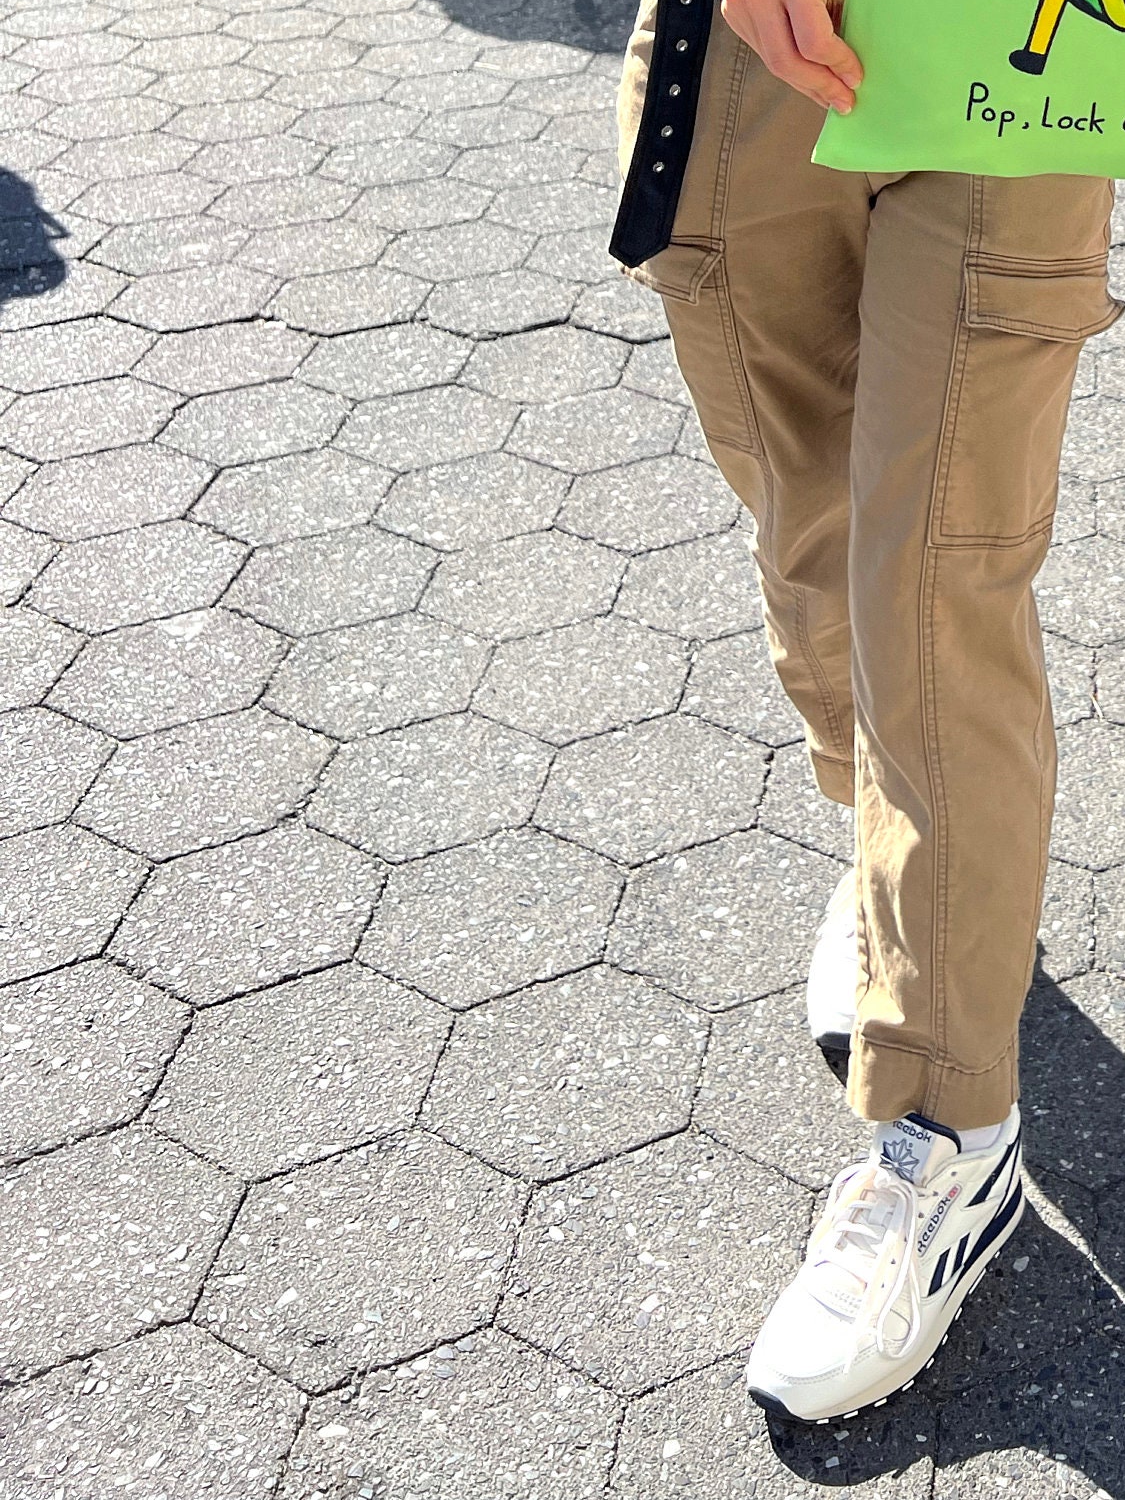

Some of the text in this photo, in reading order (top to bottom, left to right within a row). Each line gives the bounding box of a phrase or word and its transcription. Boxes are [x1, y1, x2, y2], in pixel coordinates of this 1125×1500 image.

[966, 82, 1030, 137] Pop,
[1041, 97, 1104, 134] Lock
[917, 1196, 951, 1253] Reebok
